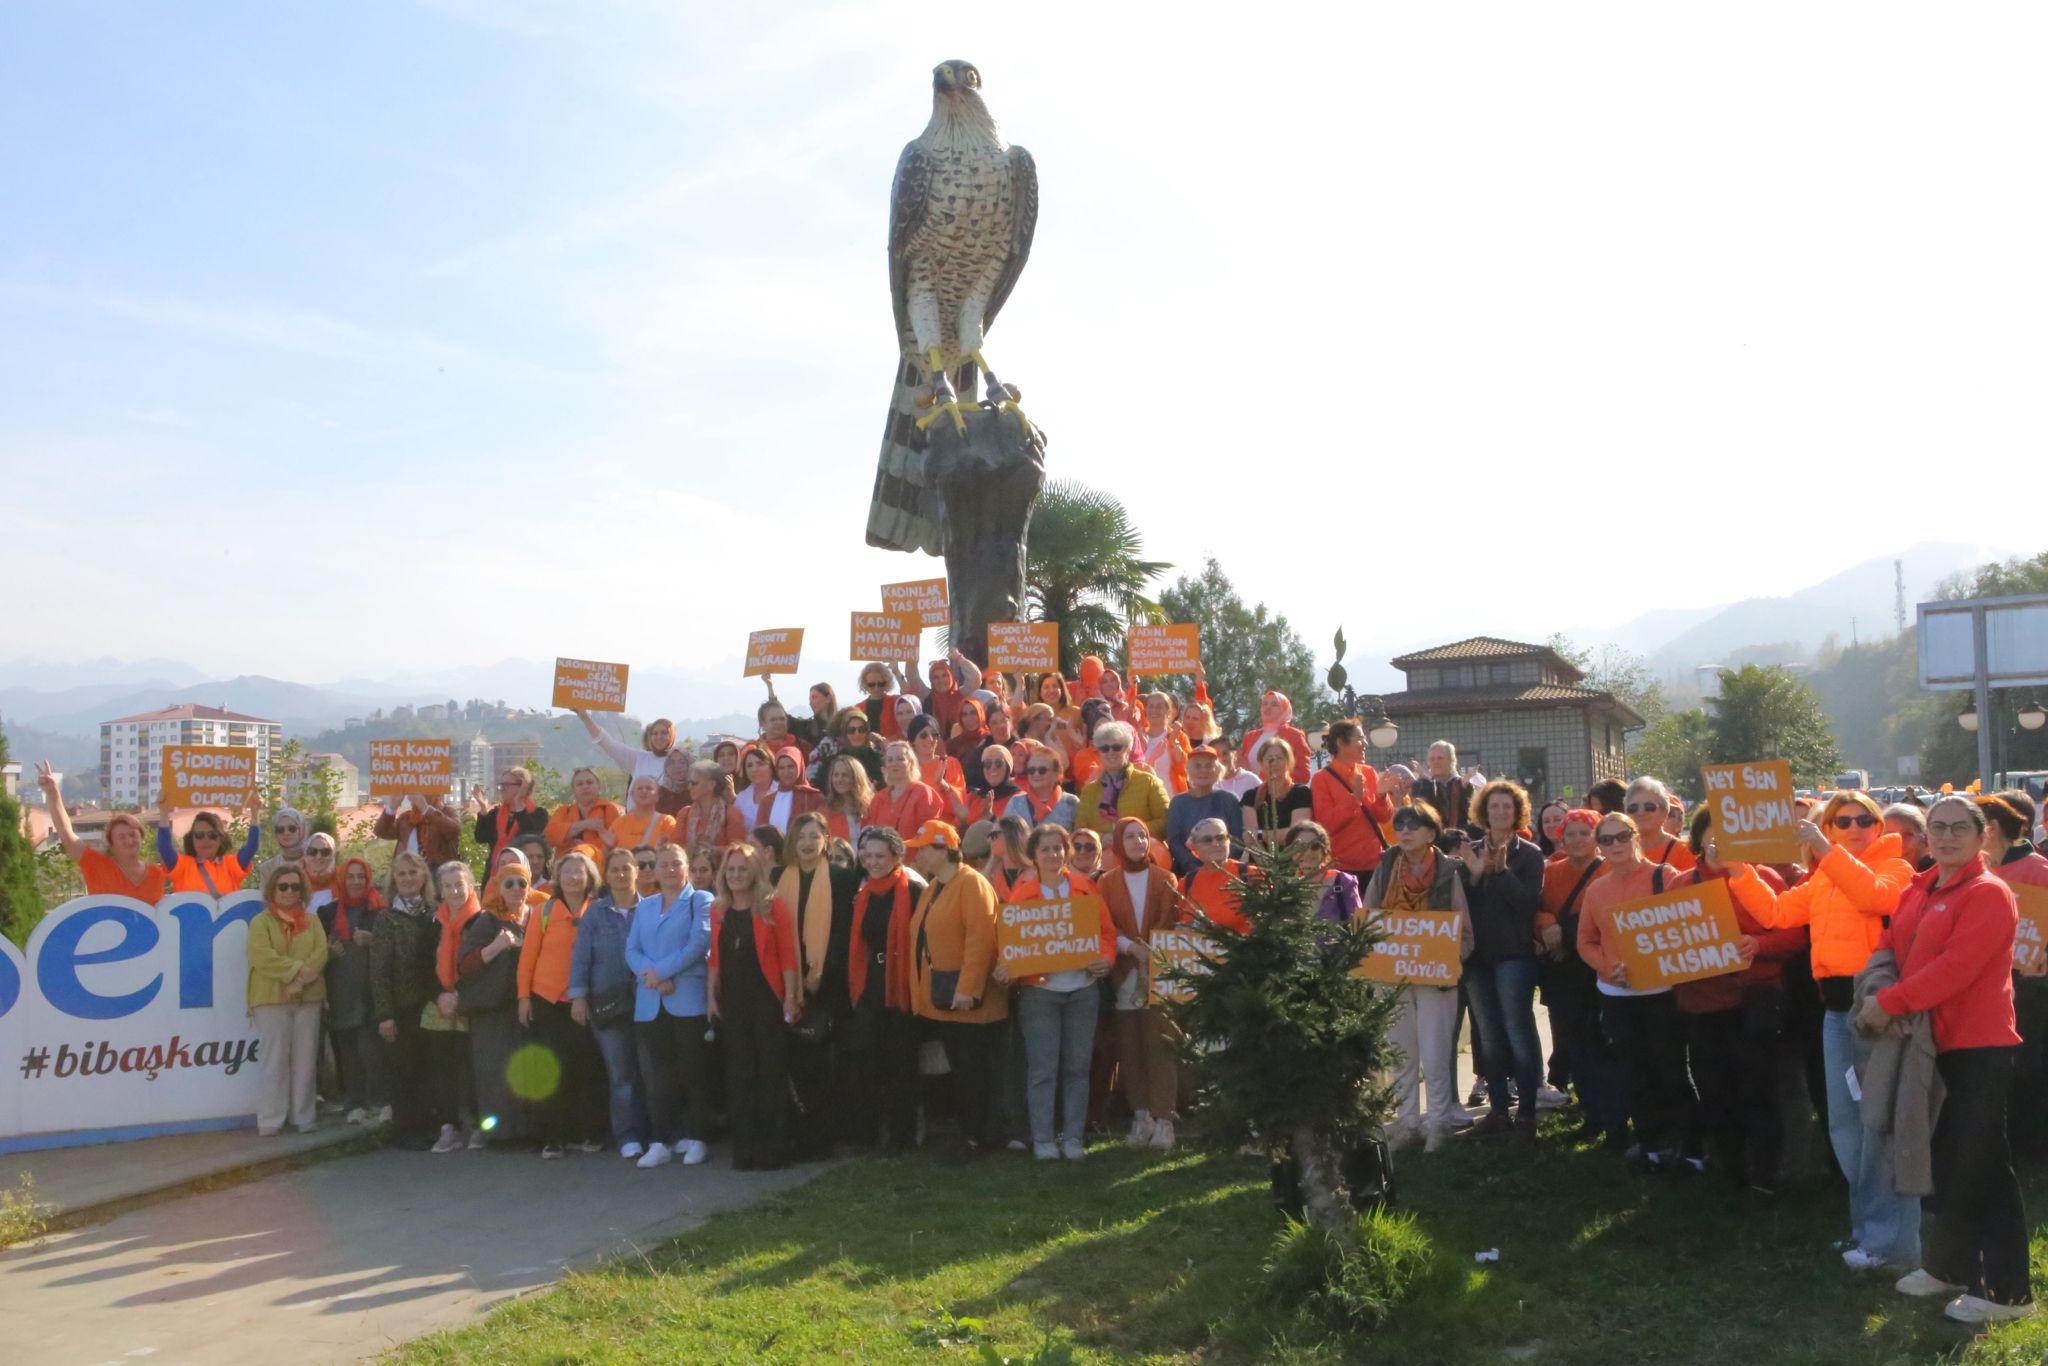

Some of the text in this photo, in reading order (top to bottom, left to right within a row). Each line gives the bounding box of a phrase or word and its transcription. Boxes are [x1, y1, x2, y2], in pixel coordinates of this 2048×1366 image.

[882, 584, 942, 598] KADINLAR
[855, 615, 902, 629] KADIN
[921, 609, 948, 623] STER!
[855, 632, 916, 646] HAYATIN
[1003, 635, 1049, 645] AKLAYAN
[989, 645, 1009, 655] HER
[371, 742, 449, 757] HER KADIN
[371, 759, 441, 772] BİR HAYAT
[176, 771, 252, 788] BAHANESİ
[370, 773, 416, 785] HAYATA
[1705, 766, 1777, 791] HEY SEN
[1002, 902, 1072, 927] ŞİDDETE
[1612, 898, 1703, 933] KADININ
[1020, 921, 1074, 940] KARŞI
[1635, 914, 1719, 954] SESİNİ
[1003, 934, 1100, 960] OMUZ OMUZA!
[1373, 941, 1422, 957] DDET
[1657, 942, 1742, 977] KISMA
[1394, 960, 1452, 979] BÜYÜR
